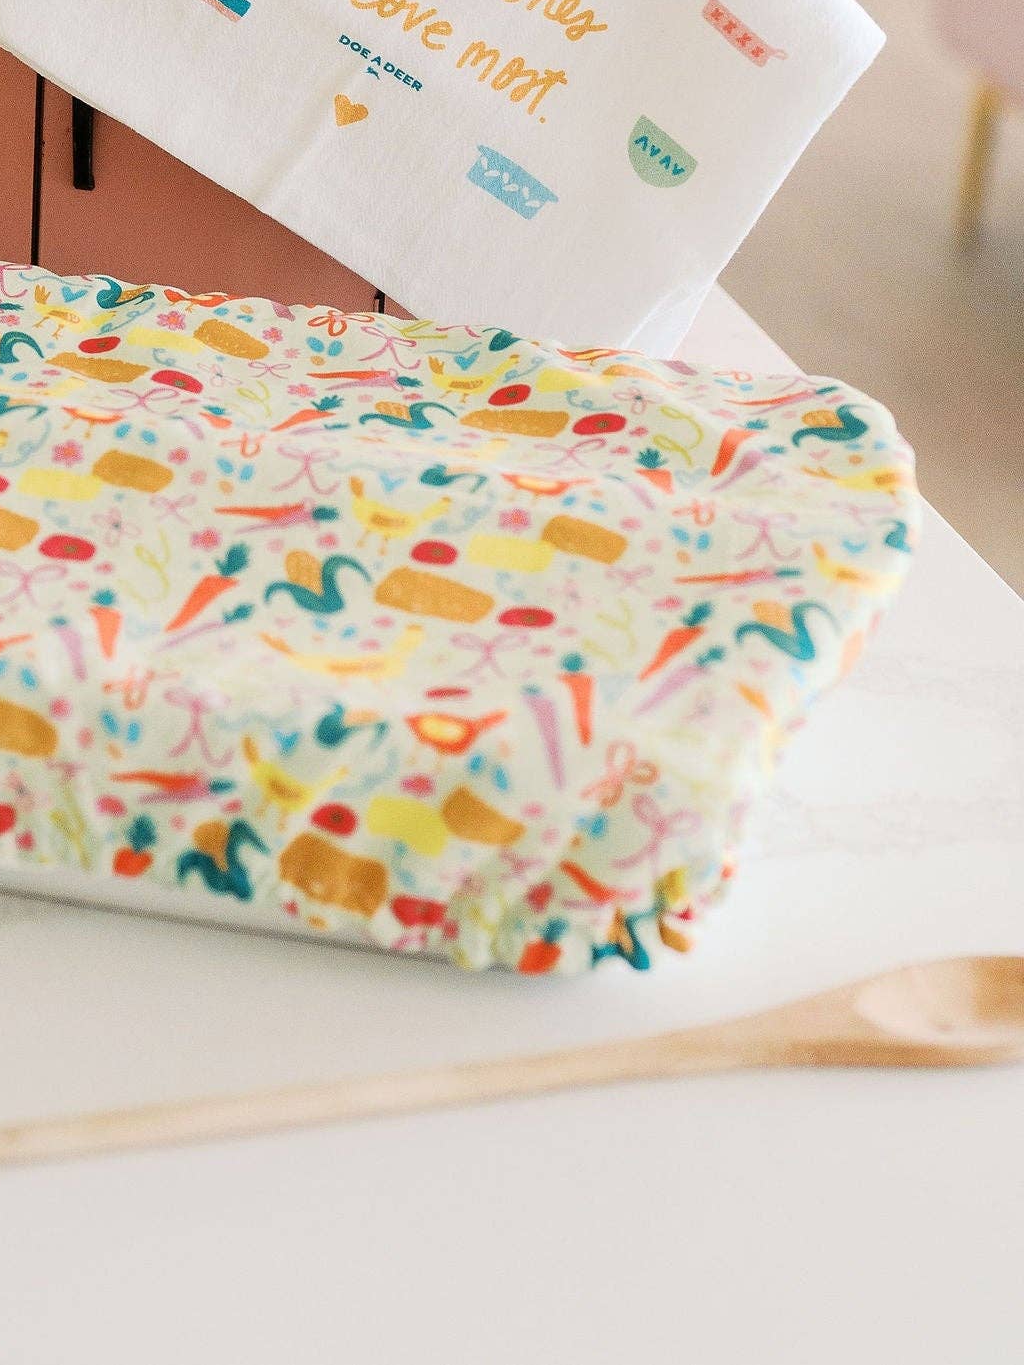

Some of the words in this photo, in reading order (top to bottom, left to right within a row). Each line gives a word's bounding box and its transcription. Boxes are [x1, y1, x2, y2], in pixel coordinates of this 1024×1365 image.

[338, 33, 372, 60] DOE
[370, 54, 383, 67] A
[382, 61, 424, 93] DEER
[455, 39, 569, 124] most.
